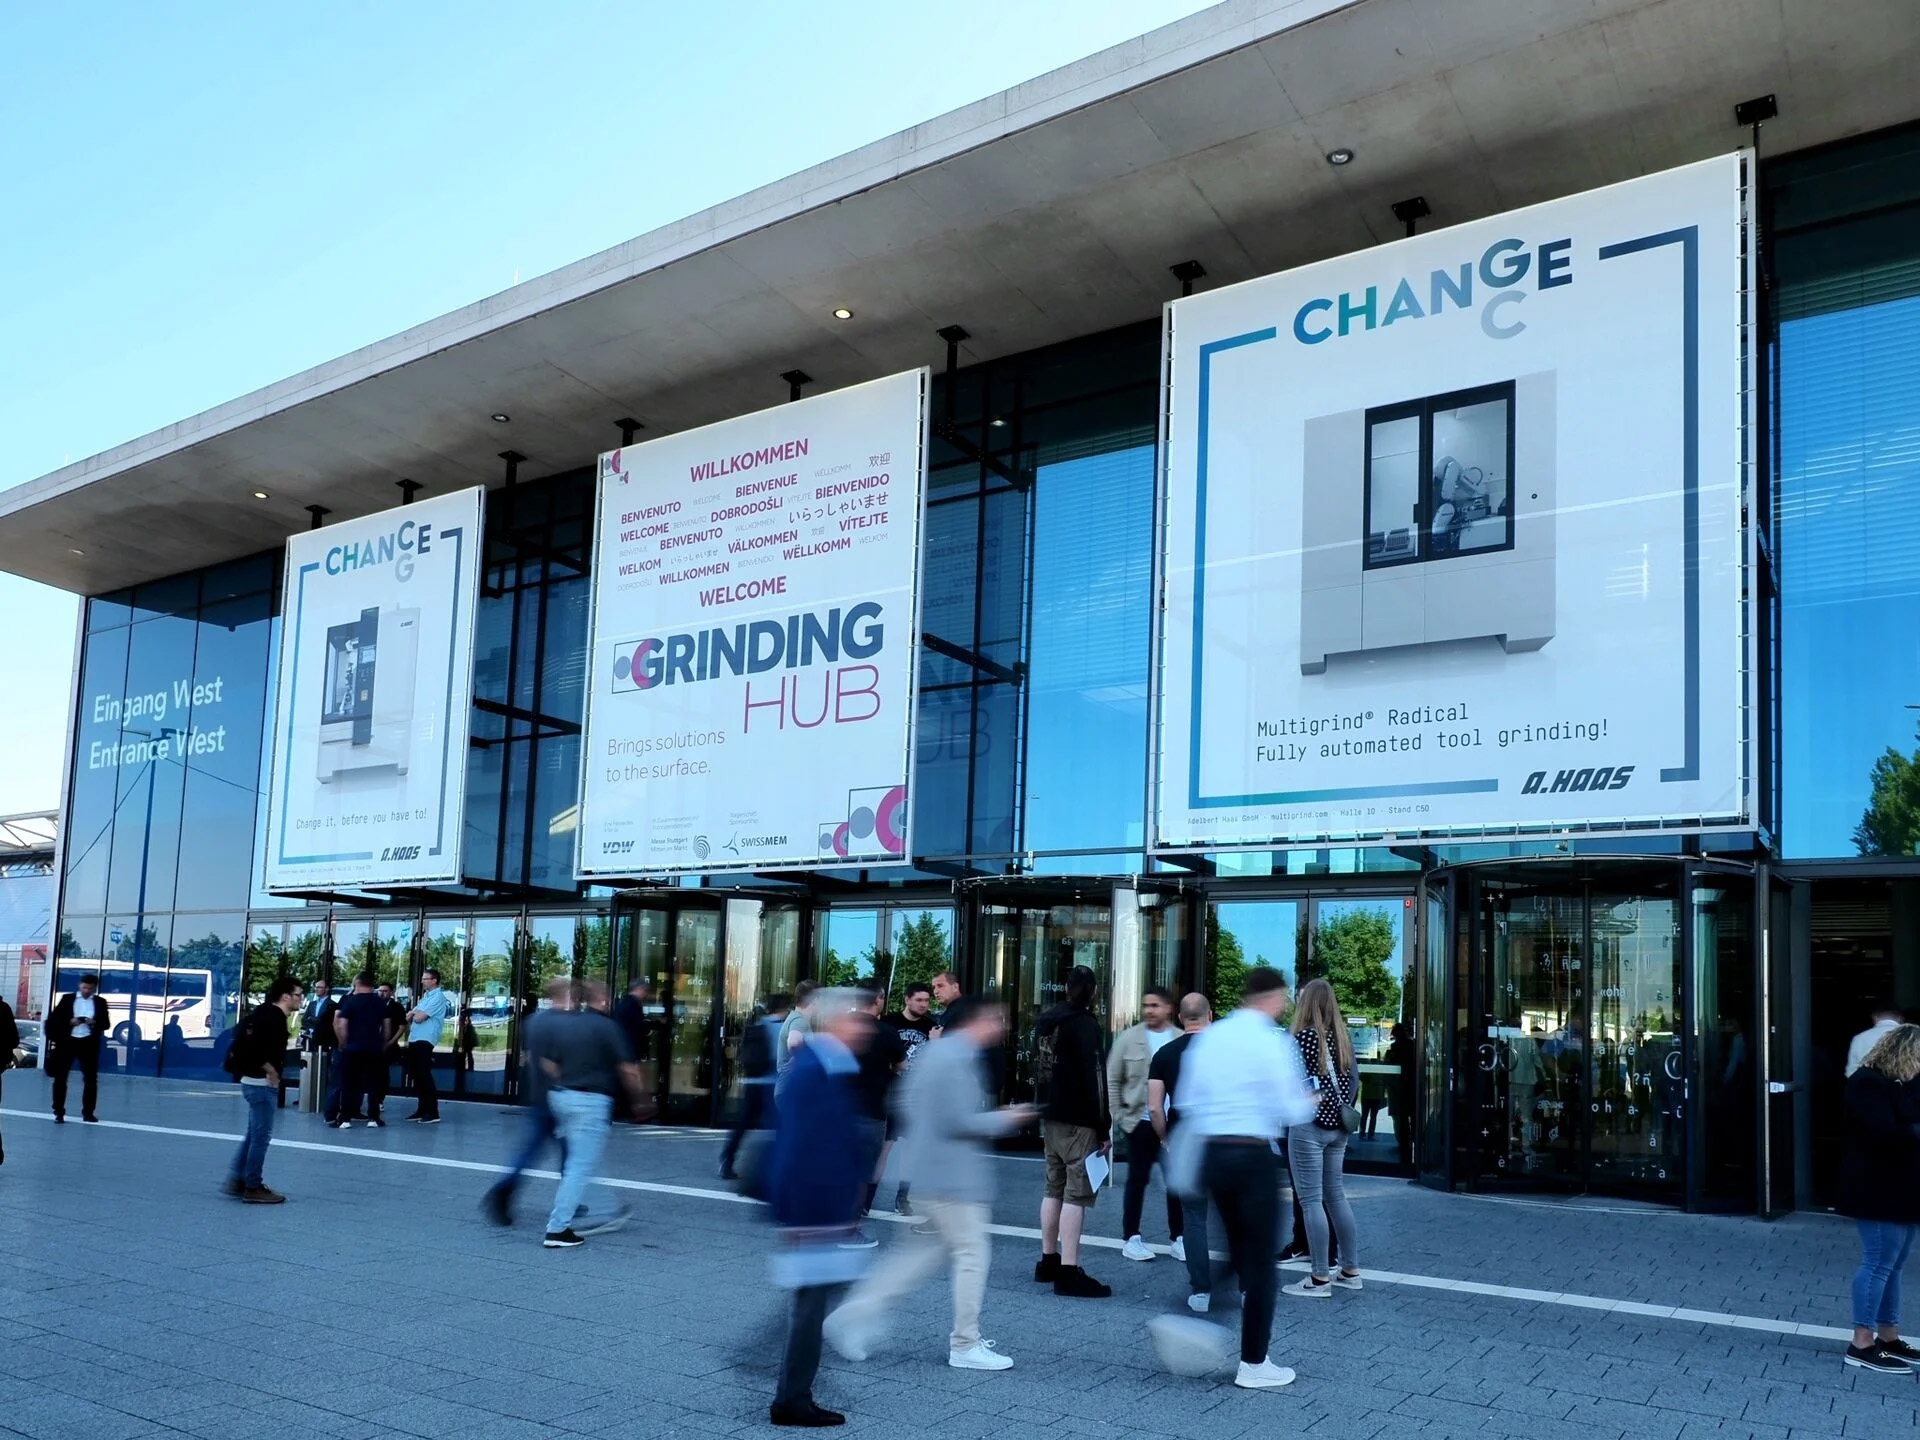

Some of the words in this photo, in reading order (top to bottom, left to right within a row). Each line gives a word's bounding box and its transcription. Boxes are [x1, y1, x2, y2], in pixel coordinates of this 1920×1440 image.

[1293, 238, 1572, 345] CHANGE
[690, 438, 808, 482] WILLKOMMEN
[868, 452, 891, 468] 欢迎
[620, 522, 669, 543] WELCOME
[711, 496, 783, 523] DOBRODOŠLI
[815, 473, 890, 500] BIENVENIDO
[621, 501, 682, 525] BENVENUTO
[735, 473, 798, 498] BIENVENUE
[789, 491, 889, 524] いらっしゃいませ
[839, 511, 889, 532] VÍTEJTE
[660, 527, 723, 550] BENVENUTO
[728, 529, 798, 554] VÄLKOMMEN
[618, 558, 661, 576] WELKOM
[659, 562, 730, 585] WILLKOMMEN
[783, 537, 851, 560] WËLLKOMM
[699, 576, 787, 607] WELCOME
[631, 601, 884, 689] GRINDING
[93, 691, 167, 727] Eingang
[173, 676, 223, 709] West
[744, 664, 881, 734] HUB
[1388, 703, 1468, 726] Radical
[89, 737, 169, 770] Entrance
[175, 725, 226, 757] West
[607, 739, 652, 757] Brings
[655, 731, 726, 751] solutions
[1257, 743, 1307, 762] Fully
[1320, 733, 1422, 758] automated
[1436, 728, 1482, 748] tool
[1498, 718, 1608, 748] grinding!
[606, 767, 621, 782] to
[624, 764, 648, 780] the
[652, 758, 711, 778] surface.
[296, 818, 321, 830] Change
[341, 814, 368, 826] before
[372, 813, 386, 825] you
[391, 810, 410, 821] have
[415, 808, 427, 819] to!
[1388, 805, 1412, 814] Stand
[602, 840, 636, 854] VDW
[741, 835, 788, 848] SWISSMEM
